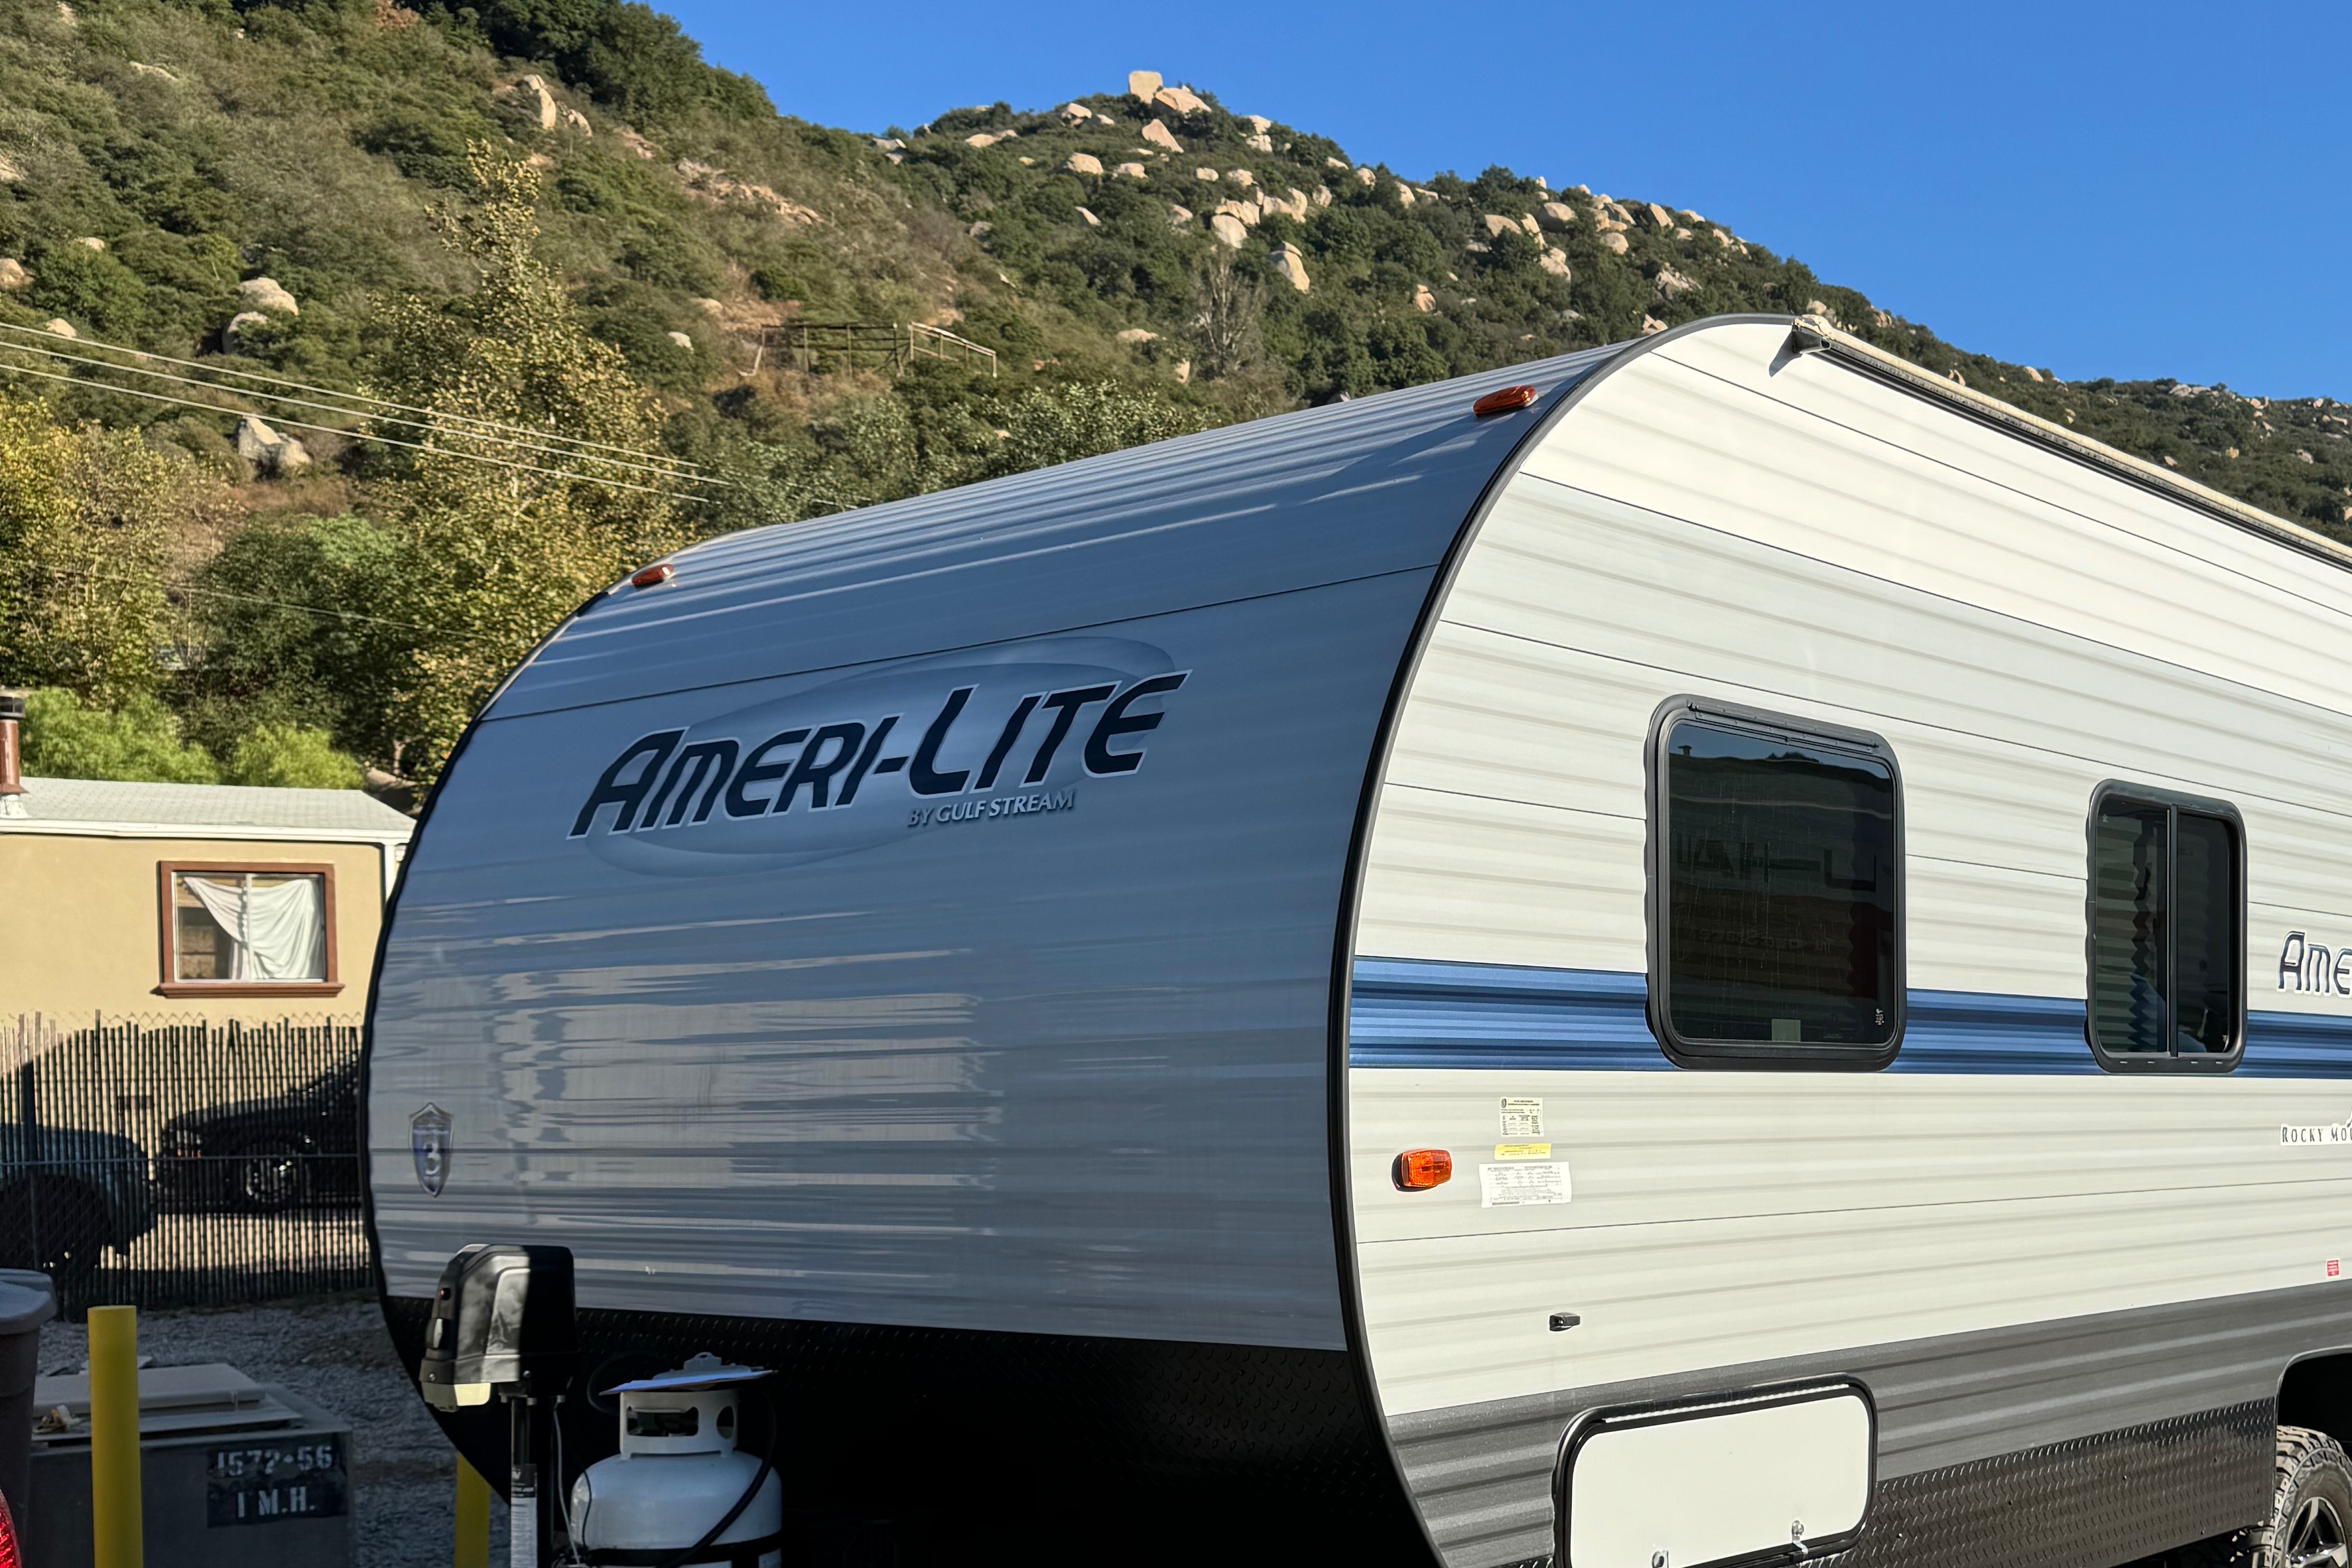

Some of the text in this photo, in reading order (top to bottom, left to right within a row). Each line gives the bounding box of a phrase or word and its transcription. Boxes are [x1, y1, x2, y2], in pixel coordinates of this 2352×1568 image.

[908, 790, 1079, 827] BY GULF STREAM
[2282, 1126, 2323, 1143] ROCKY
